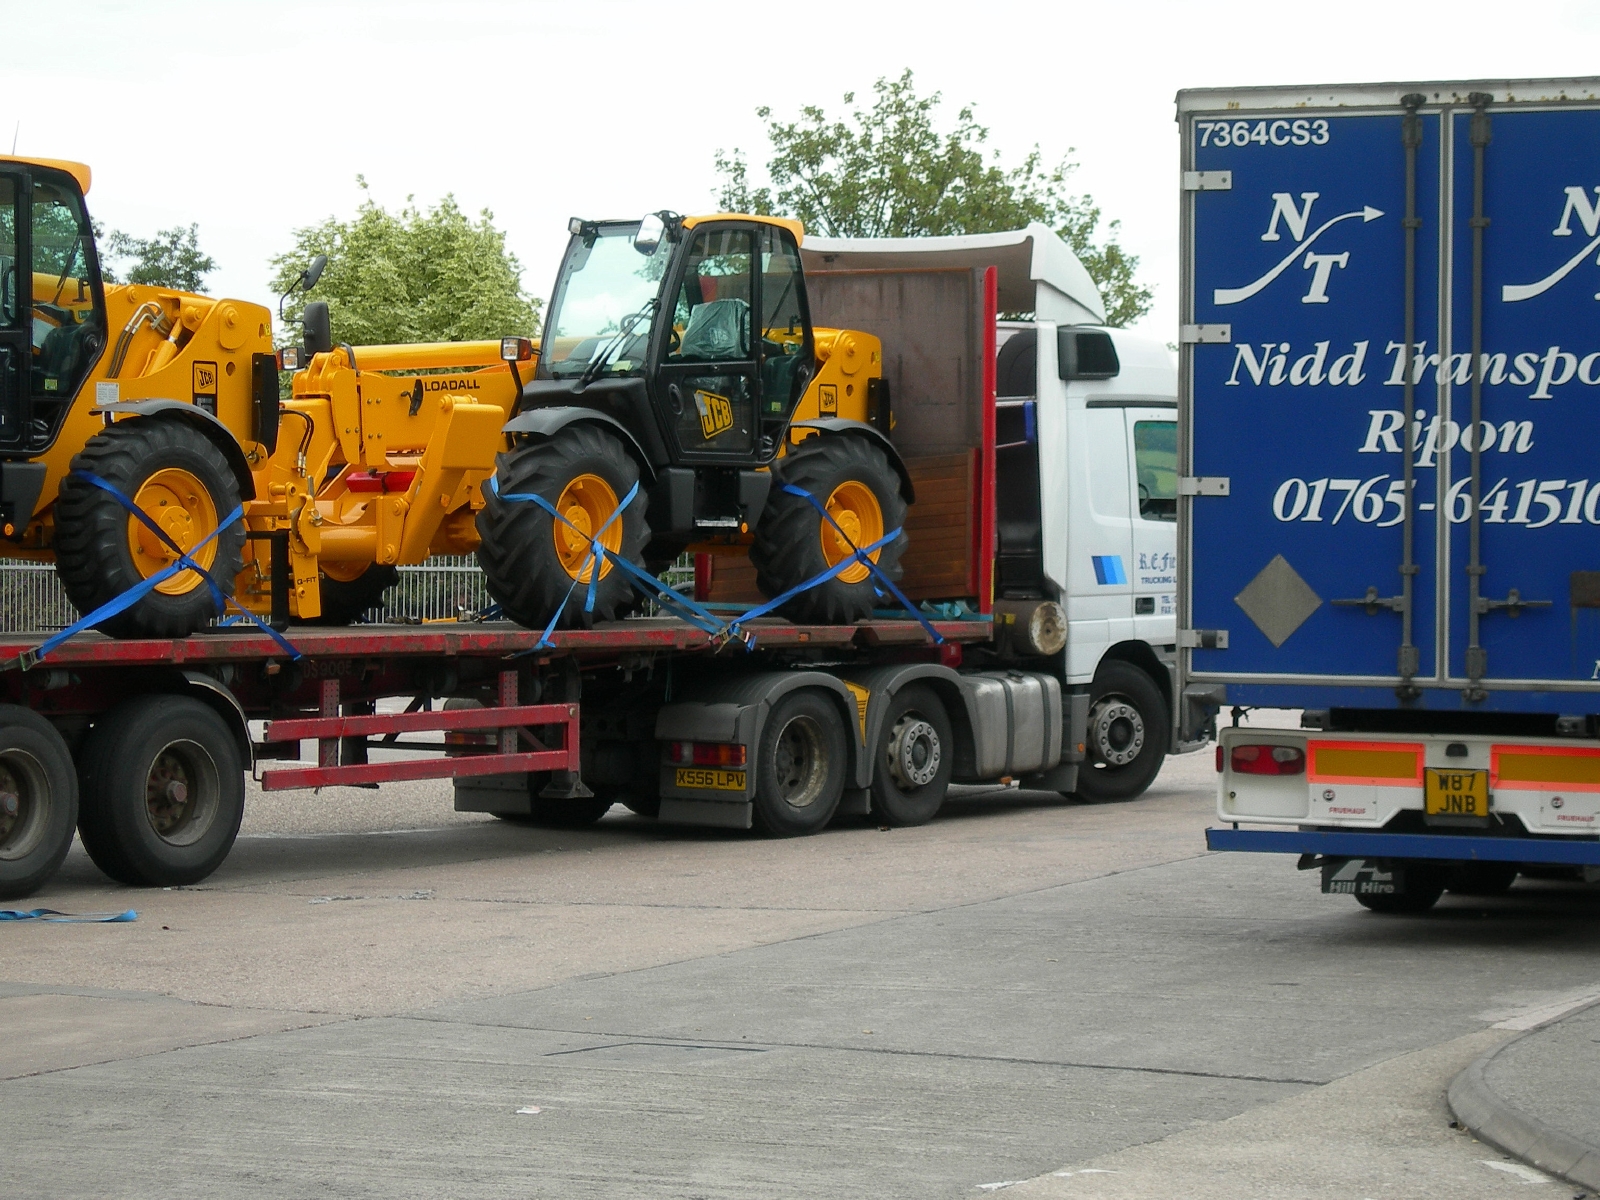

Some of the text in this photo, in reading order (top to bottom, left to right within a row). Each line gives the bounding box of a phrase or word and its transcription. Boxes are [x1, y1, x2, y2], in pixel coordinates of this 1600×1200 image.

[1197, 119, 1330, 147] 7364CS3
[1225, 340, 1369, 386] Nidd
[198, 370, 213, 387] JCB
[424, 379, 480, 392] LOADALL
[702, 395, 731, 433] JCB
[1358, 408, 1534, 468] Ripon
[297, 577, 316, 585] Q-FIT
[1141, 576, 1172, 584] TRUCKING
[677, 770, 744, 787] X556 LPV
[1438, 773, 1475, 791] W87
[1439, 794, 1476, 812] JNB
[1329, 881, 1395, 894] Hill Hire
